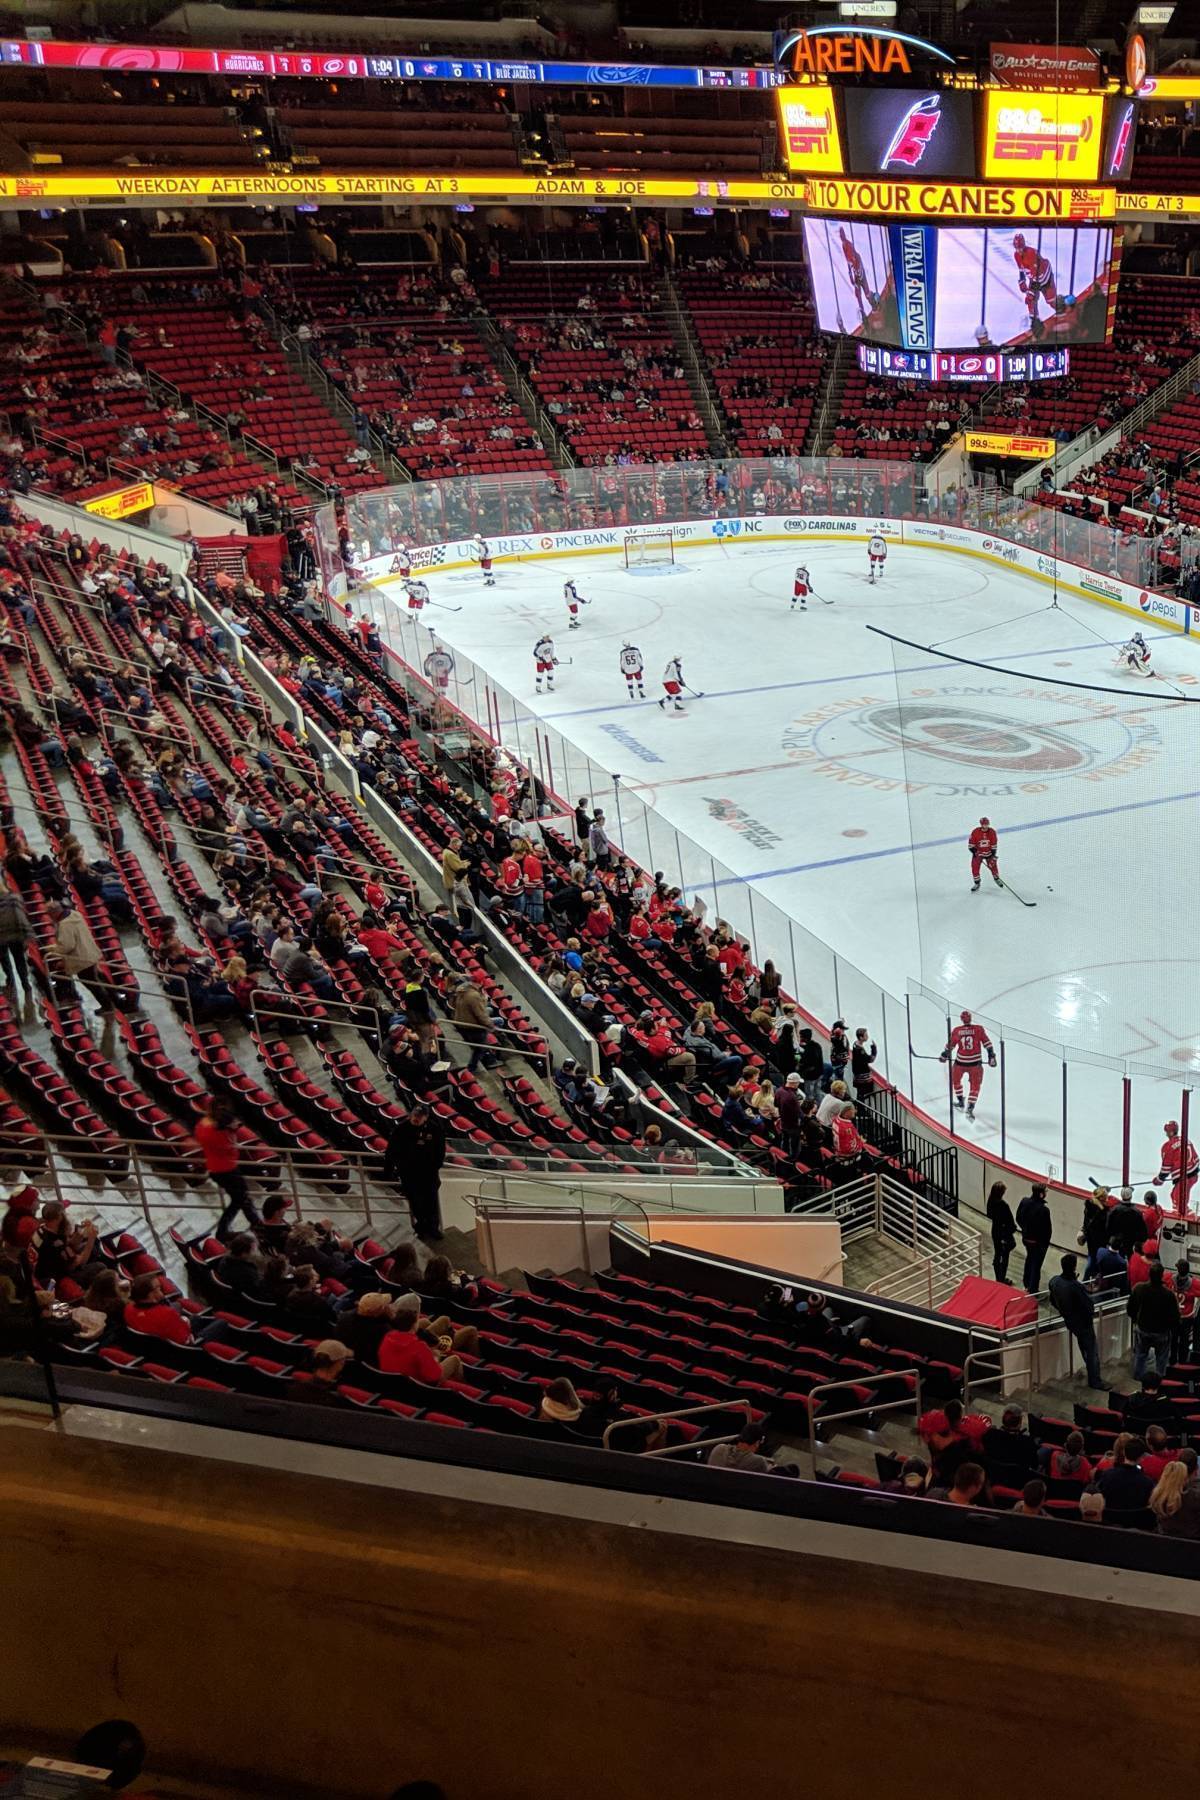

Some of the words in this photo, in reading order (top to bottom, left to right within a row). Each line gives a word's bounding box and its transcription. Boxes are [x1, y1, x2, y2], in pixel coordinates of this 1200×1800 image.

[794, 30, 911, 73] ARENA
[225, 60, 265, 71] HURRICANES
[303, 63, 311, 72] 0
[349, 59, 357, 74] 0
[372, 60, 393, 72] 1:04
[405, 61, 414, 76] 0
[454, 68, 462, 77] 0
[1067, 60, 1099, 71] GAME
[496, 68, 511, 79] BLUE
[512, 69, 537, 79] JACKETS
[994, 132, 1078, 161] ESPN
[117, 179, 200, 193] WEEKDAY
[211, 178, 326, 193] AFTERNOONS
[336, 179, 415, 192] STARTING
[425, 179, 443, 191] AT
[449, 179, 459, 192] 3
[535, 181, 585, 193] ADAM
[595, 181, 606, 193] &
[615, 181, 646, 194] JOE
[771, 184, 796, 197] ON
[819, 184, 839, 205] TO
[843, 183, 911, 212] YOUR
[919, 186, 1016, 216] CANES
[1025, 189, 1062, 216] ON
[1071, 189, 1088, 201] 99.9
[1155, 197, 1173, 210] AT
[1176, 197, 1184, 211] 3
[904, 231, 924, 282] WRAL
[908, 285, 925, 345] NEWS
[884, 352, 890, 368] 0
[920, 358, 927, 369] 0
[941, 358, 948, 371] 0
[985, 356, 996, 375] 0
[1008, 357, 1026, 373] 1:04
[1035, 355, 1043, 371] 0
[970, 438, 988, 449] 99.9
[1011, 439, 1049, 453] ESPN
[121, 487, 149, 509] ESPN
[744, 520, 763, 532] NC
[787, 520, 804, 530] FOX
[808, 520, 857, 531] CAROLINAS
[913, 528, 938, 536] VECTOR
[499, 537, 534, 553] REX
[556, 536, 585, 547] PNC
[586, 532, 618, 546] BANK
[1085, 573, 1103, 588] Harris
[1103, 580, 1123, 594] Teeter
[1152, 600, 1177, 618] pepsi
[781, 727, 812, 749] PNC
[960, 1035, 974, 1050] 13
